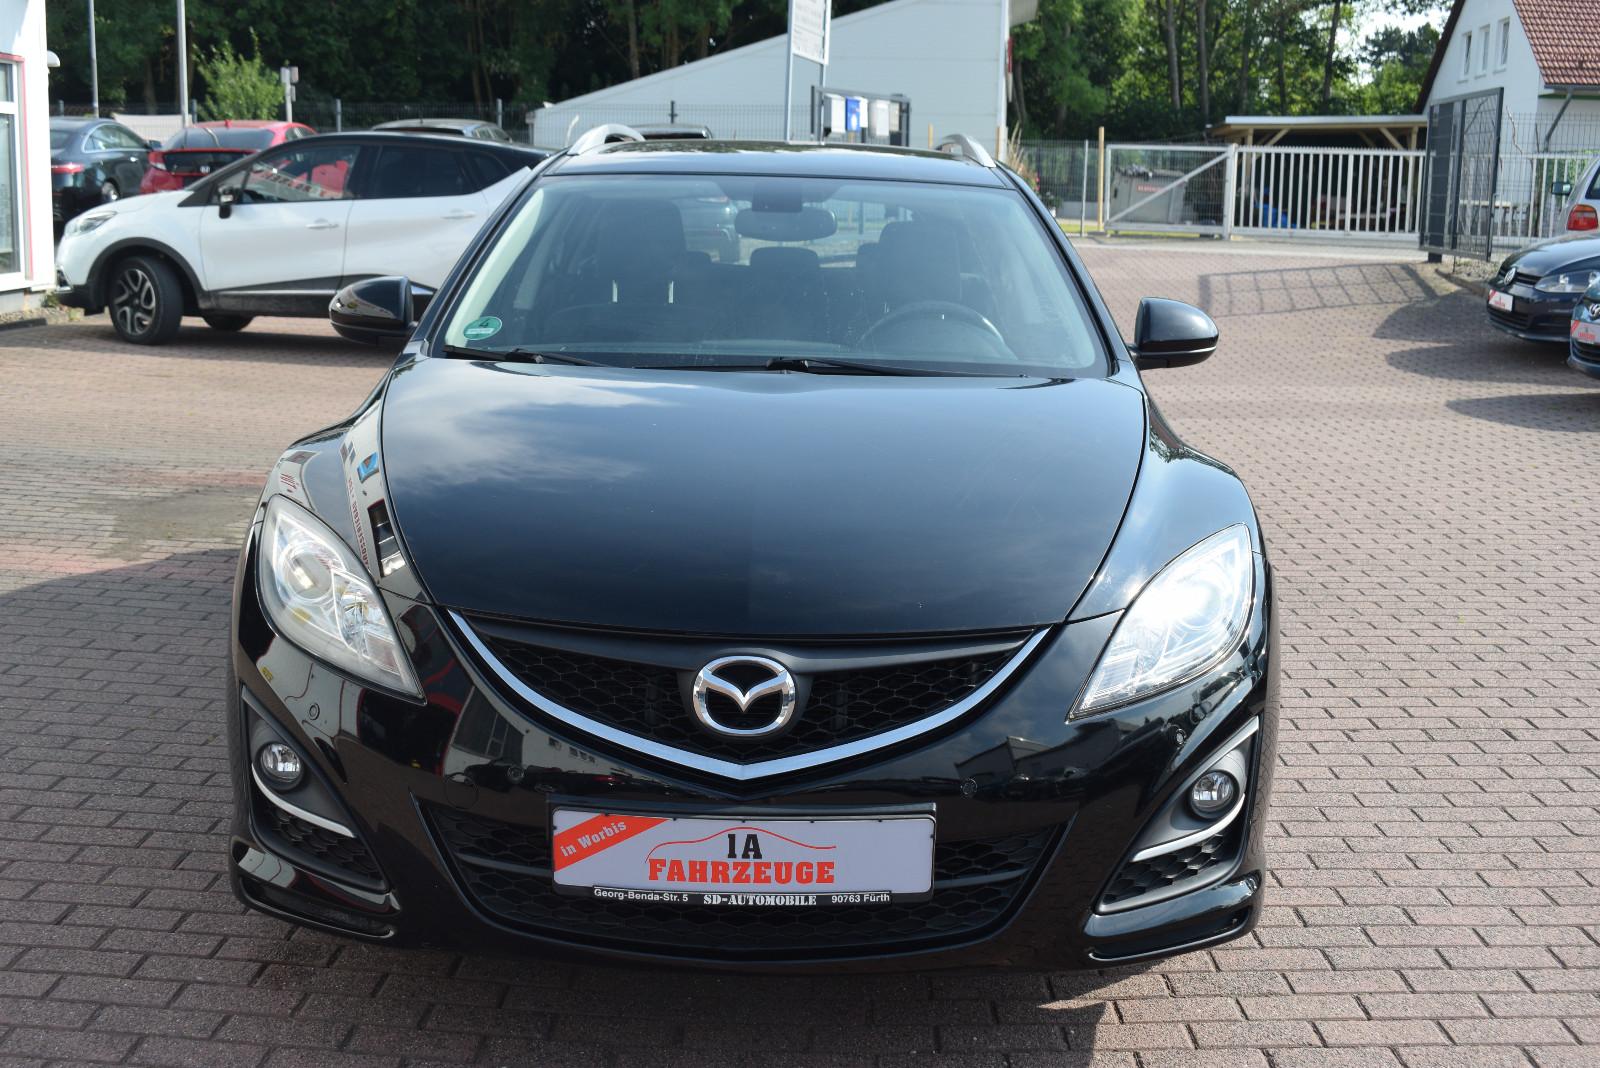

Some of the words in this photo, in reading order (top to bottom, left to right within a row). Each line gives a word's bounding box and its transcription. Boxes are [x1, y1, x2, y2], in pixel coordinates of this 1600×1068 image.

[560, 844, 577, 857] in
[578, 821, 627, 848] Worbis
[648, 858, 835, 884] FAHRZEUGE
[593, 887, 680, 902] Georg-Benda-Str.
[682, 893, 689, 902] 5
[703, 894, 817, 906] SD-AUTOMOBILE
[831, 893, 861, 903] 90763
[864, 892, 890, 903] Fürth
